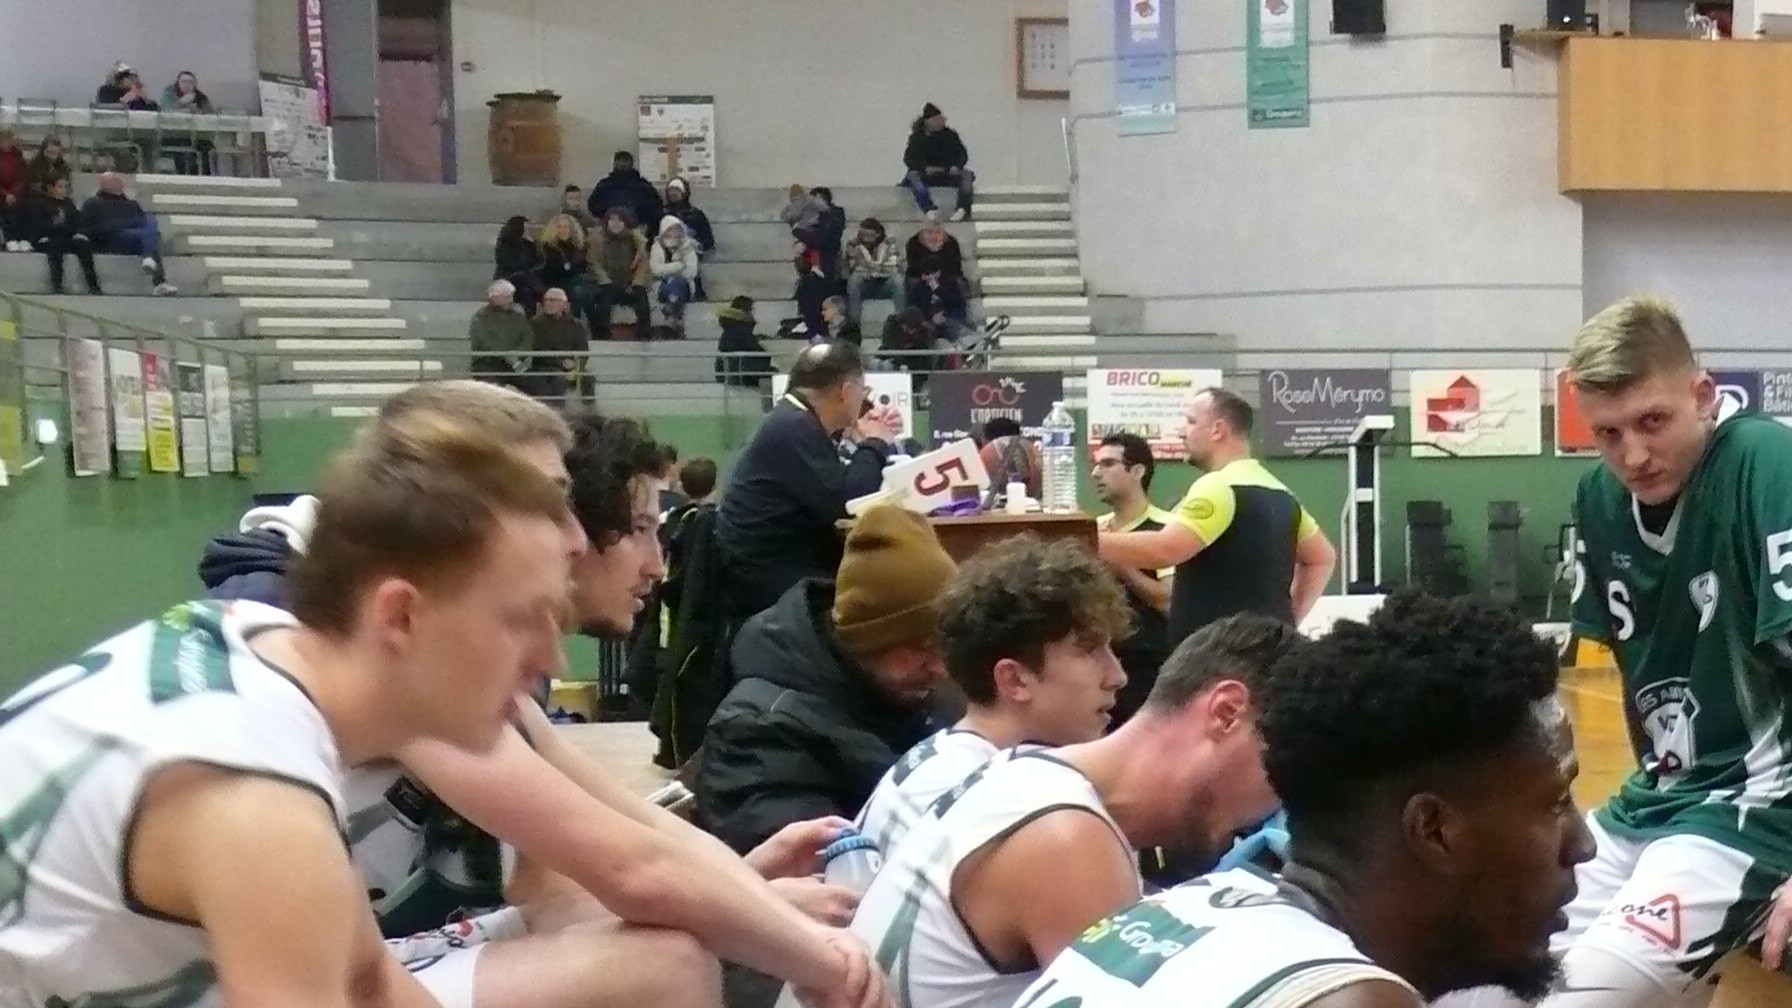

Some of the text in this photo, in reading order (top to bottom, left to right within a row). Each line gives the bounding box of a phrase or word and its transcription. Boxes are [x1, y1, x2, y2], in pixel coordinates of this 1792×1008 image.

[1106, 371, 1160, 386] BRICO
[1763, 387, 1774, 398] &
[914, 456, 968, 497] 5
